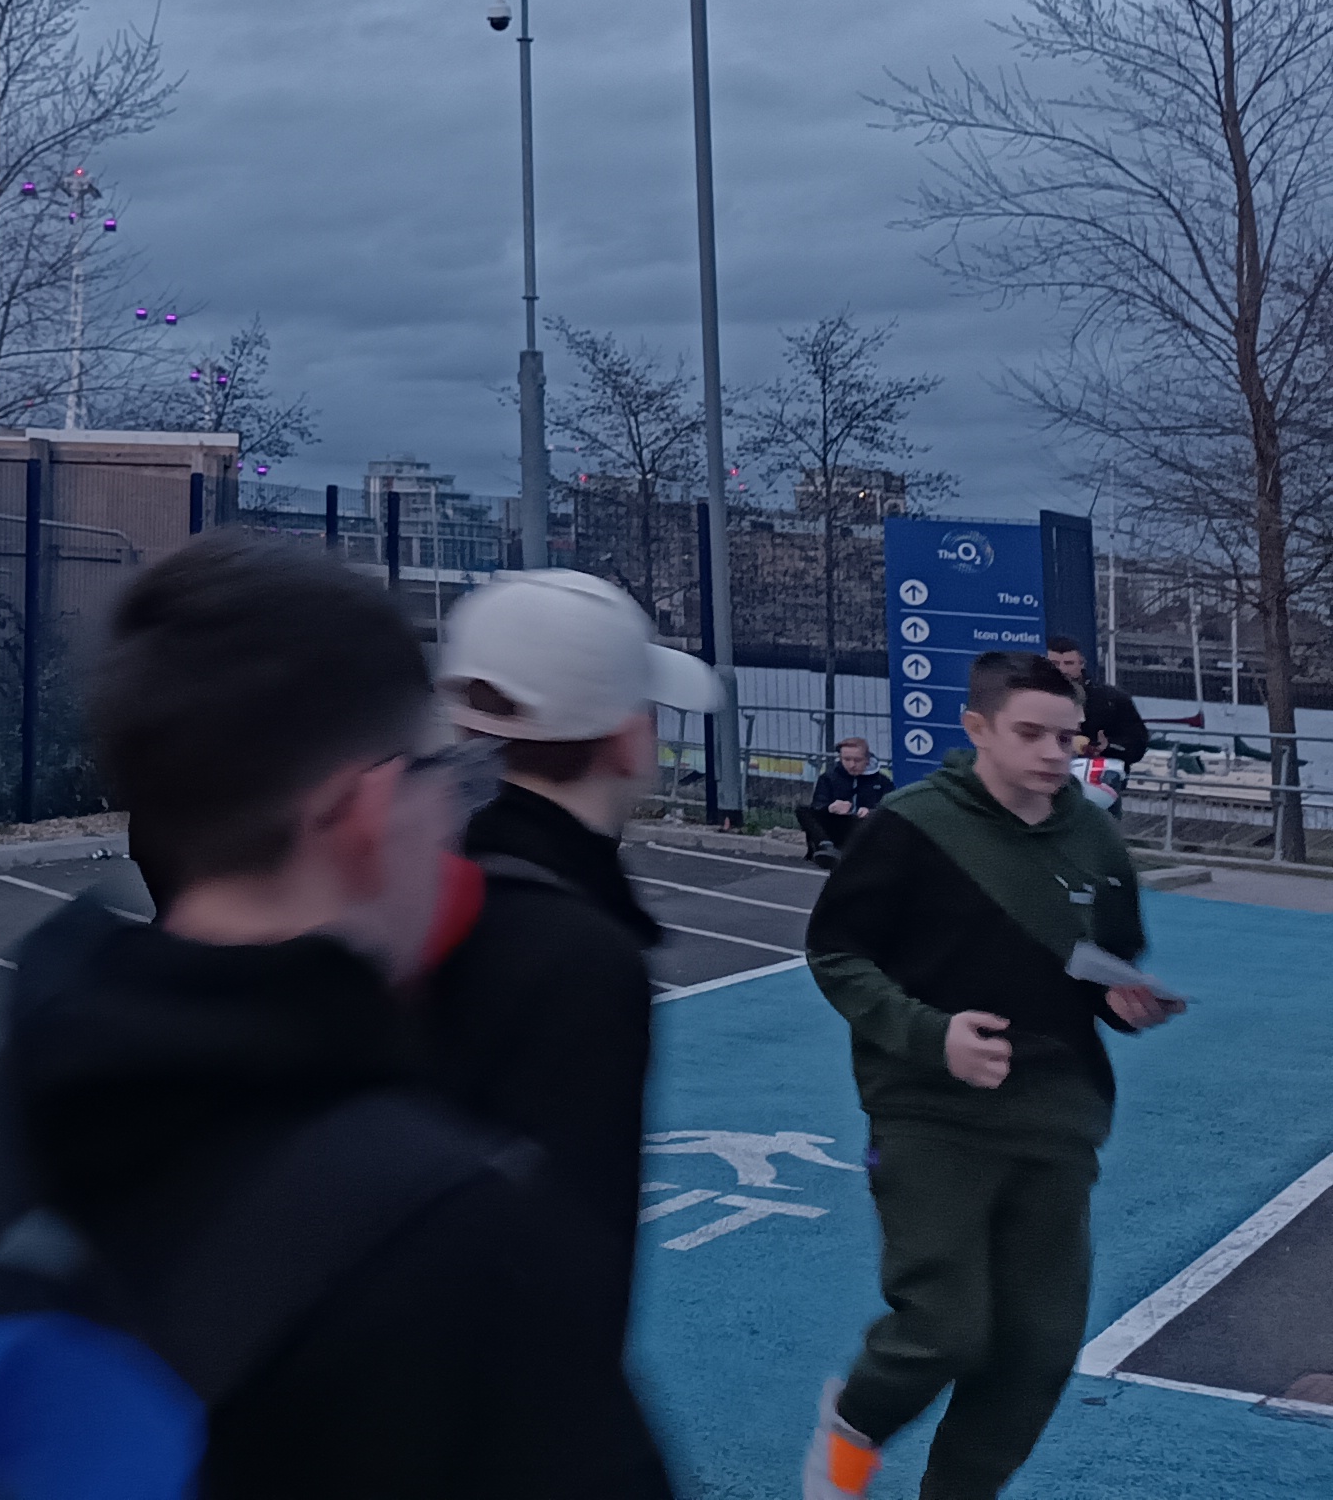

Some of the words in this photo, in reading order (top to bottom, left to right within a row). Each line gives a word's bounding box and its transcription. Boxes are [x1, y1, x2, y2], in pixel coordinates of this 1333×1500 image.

[937, 549, 958, 560] The
[997, 592, 1021, 605] The
[973, 628, 999, 641] Icon
[1000, 630, 1041, 644] Outlet
